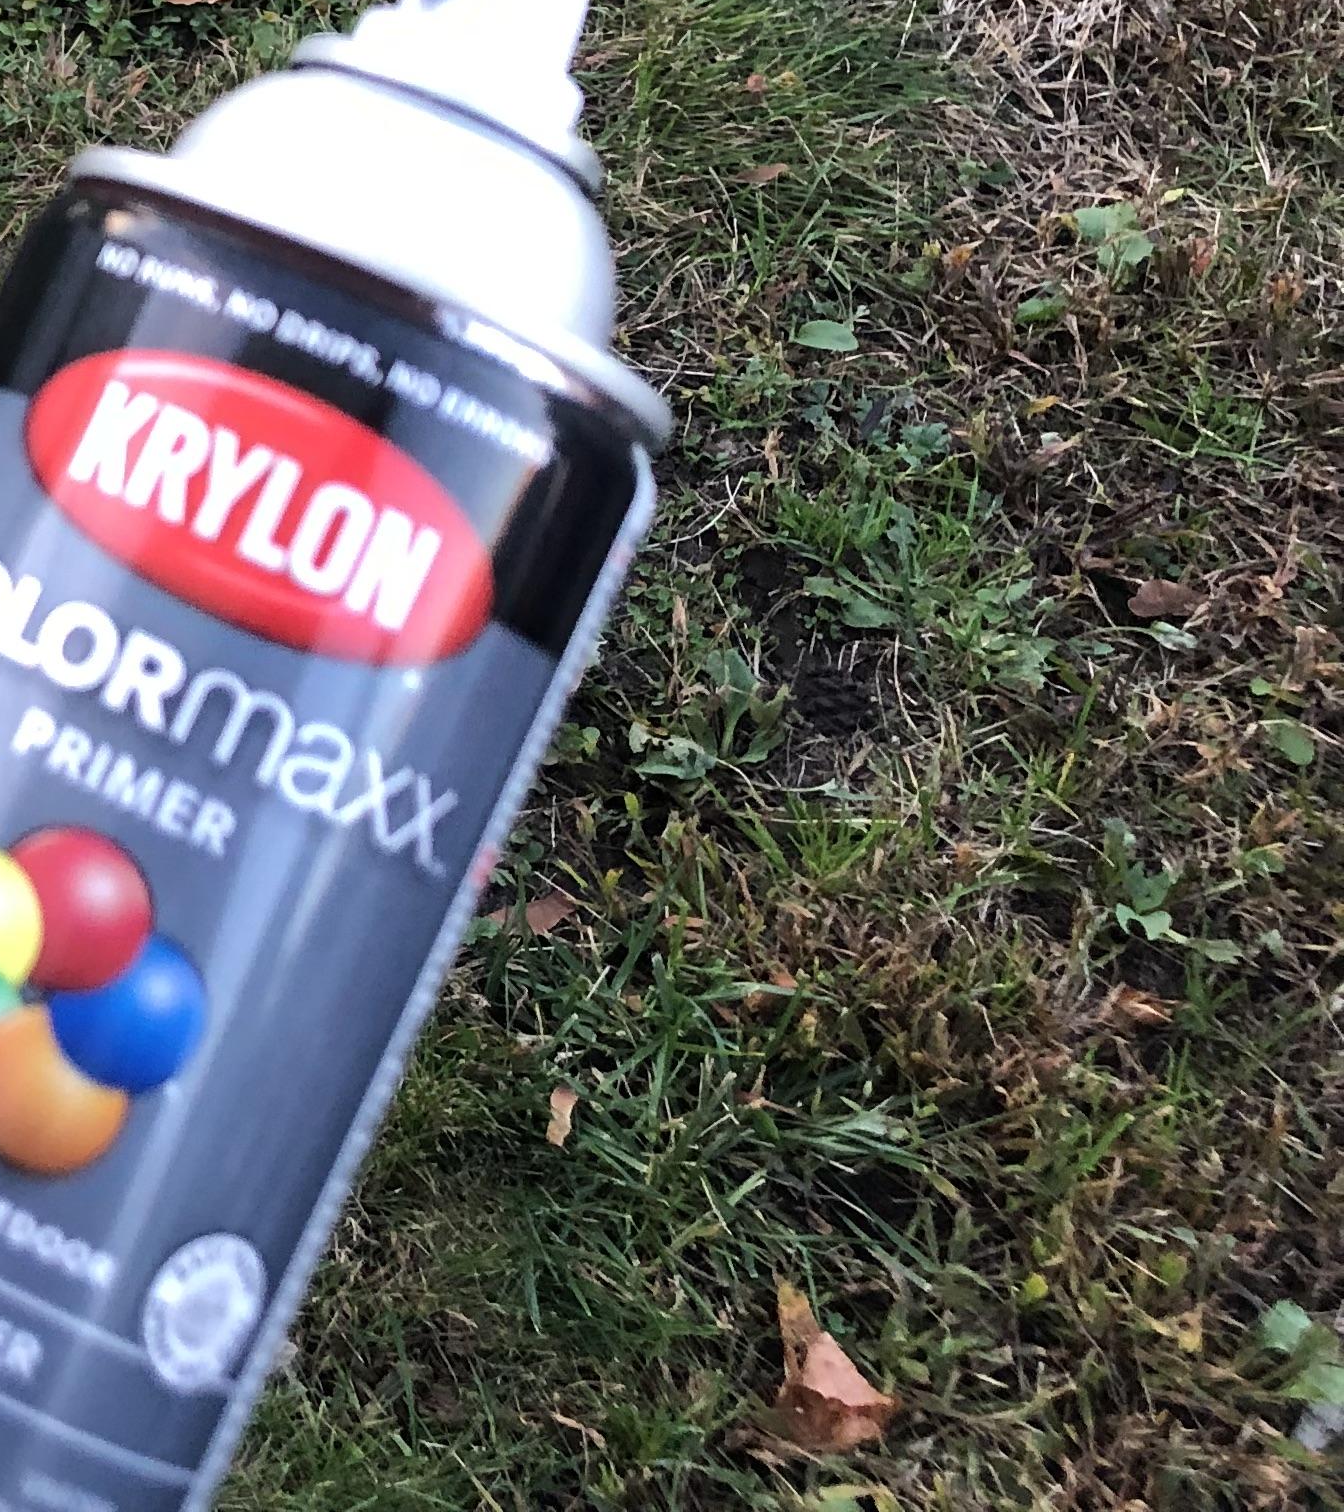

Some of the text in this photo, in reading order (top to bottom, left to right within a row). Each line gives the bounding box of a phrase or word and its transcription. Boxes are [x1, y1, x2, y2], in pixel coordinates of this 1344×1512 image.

[95, 241, 141, 281] NO
[223, 288, 280, 332] NO
[383, 358, 442, 409] NO
[66, 379, 441, 632] KRYLON
[11, 705, 239, 861] PRIMER
